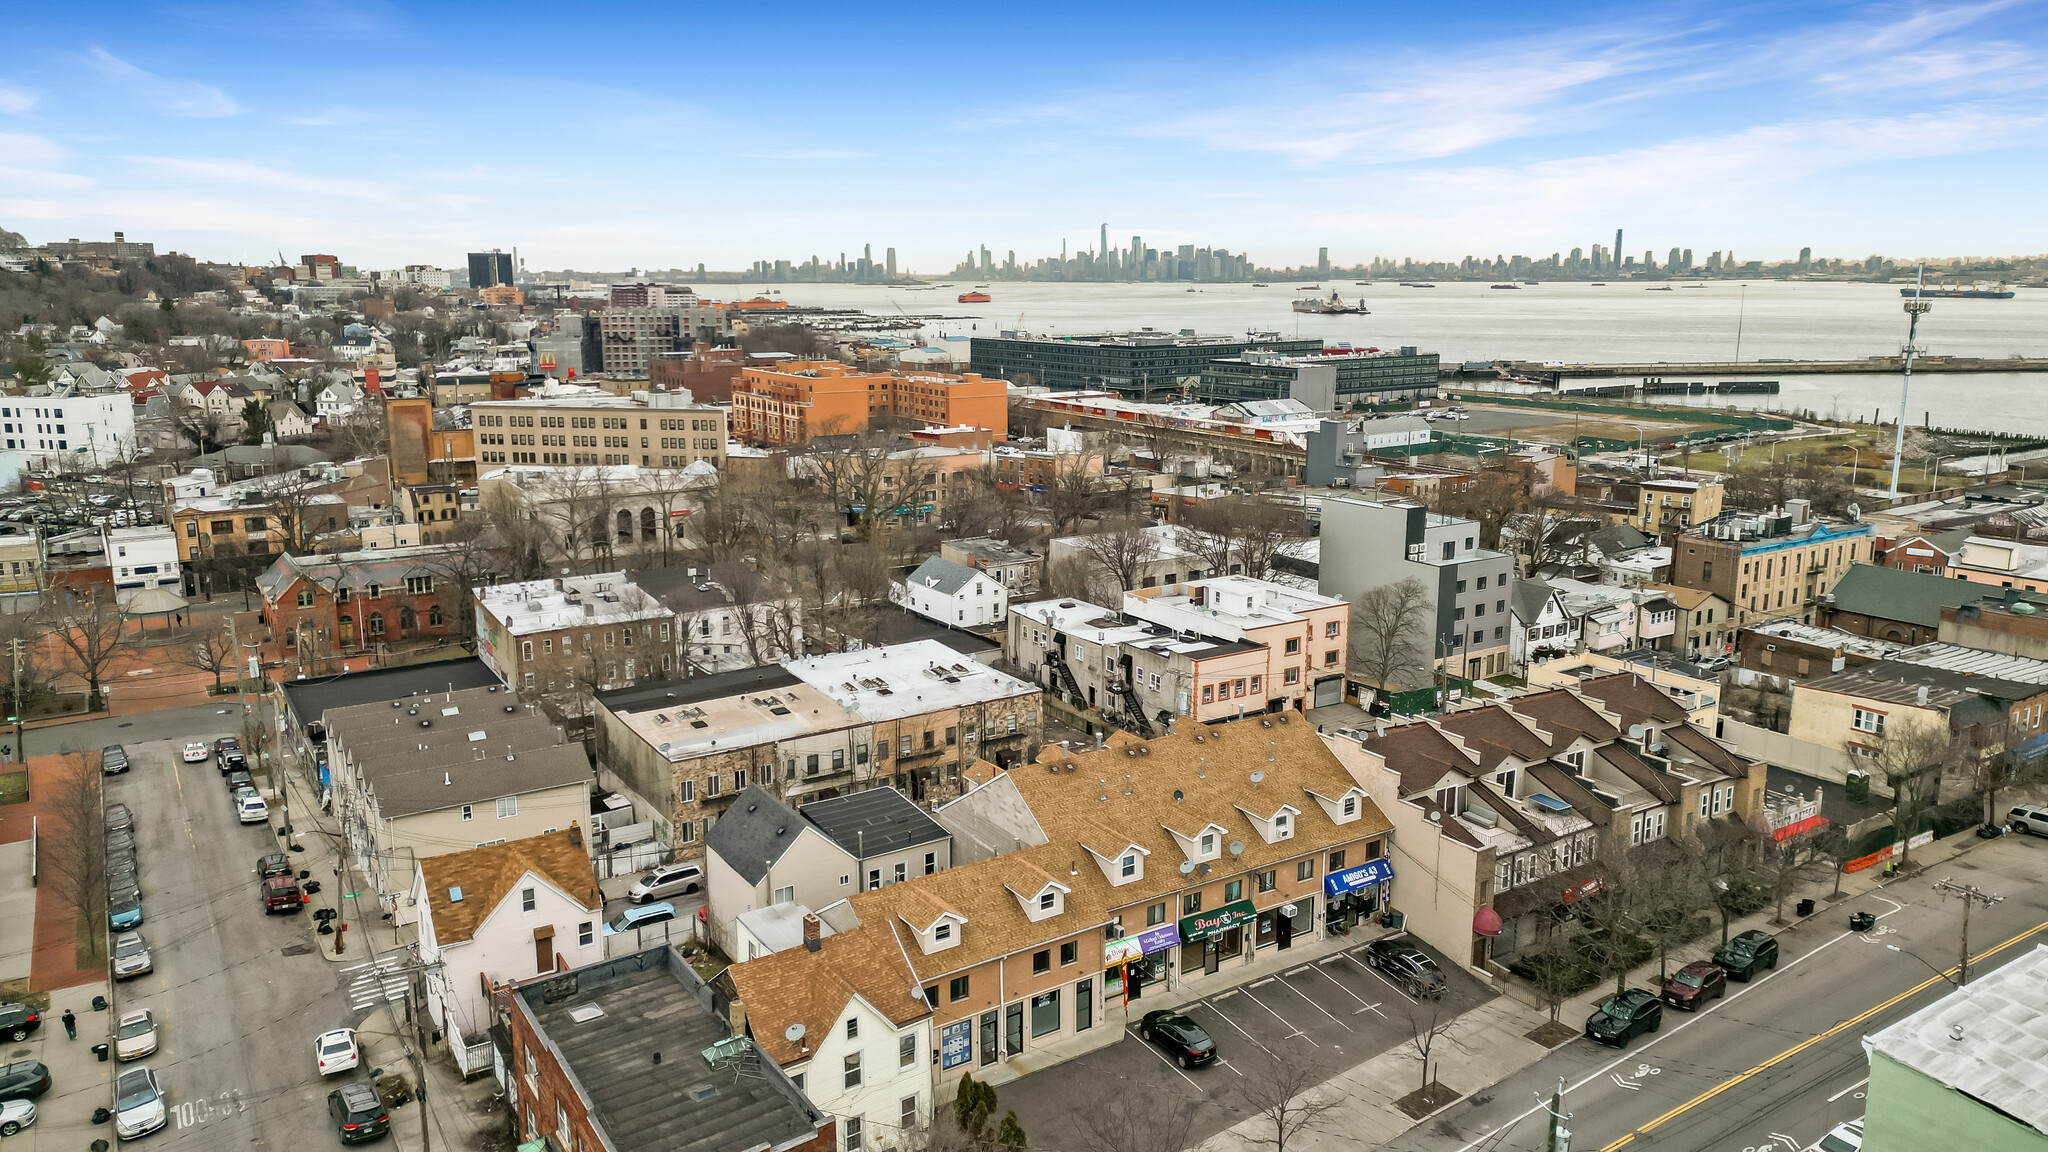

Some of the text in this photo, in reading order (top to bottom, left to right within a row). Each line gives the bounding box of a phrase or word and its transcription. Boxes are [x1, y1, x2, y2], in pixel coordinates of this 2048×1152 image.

[1342, 869, 1369, 884] AMIGO'S
[1368, 865, 1379, 876] 43
[1194, 917, 1222, 931] Bay
[1207, 922, 1241, 936] PHARMACY
